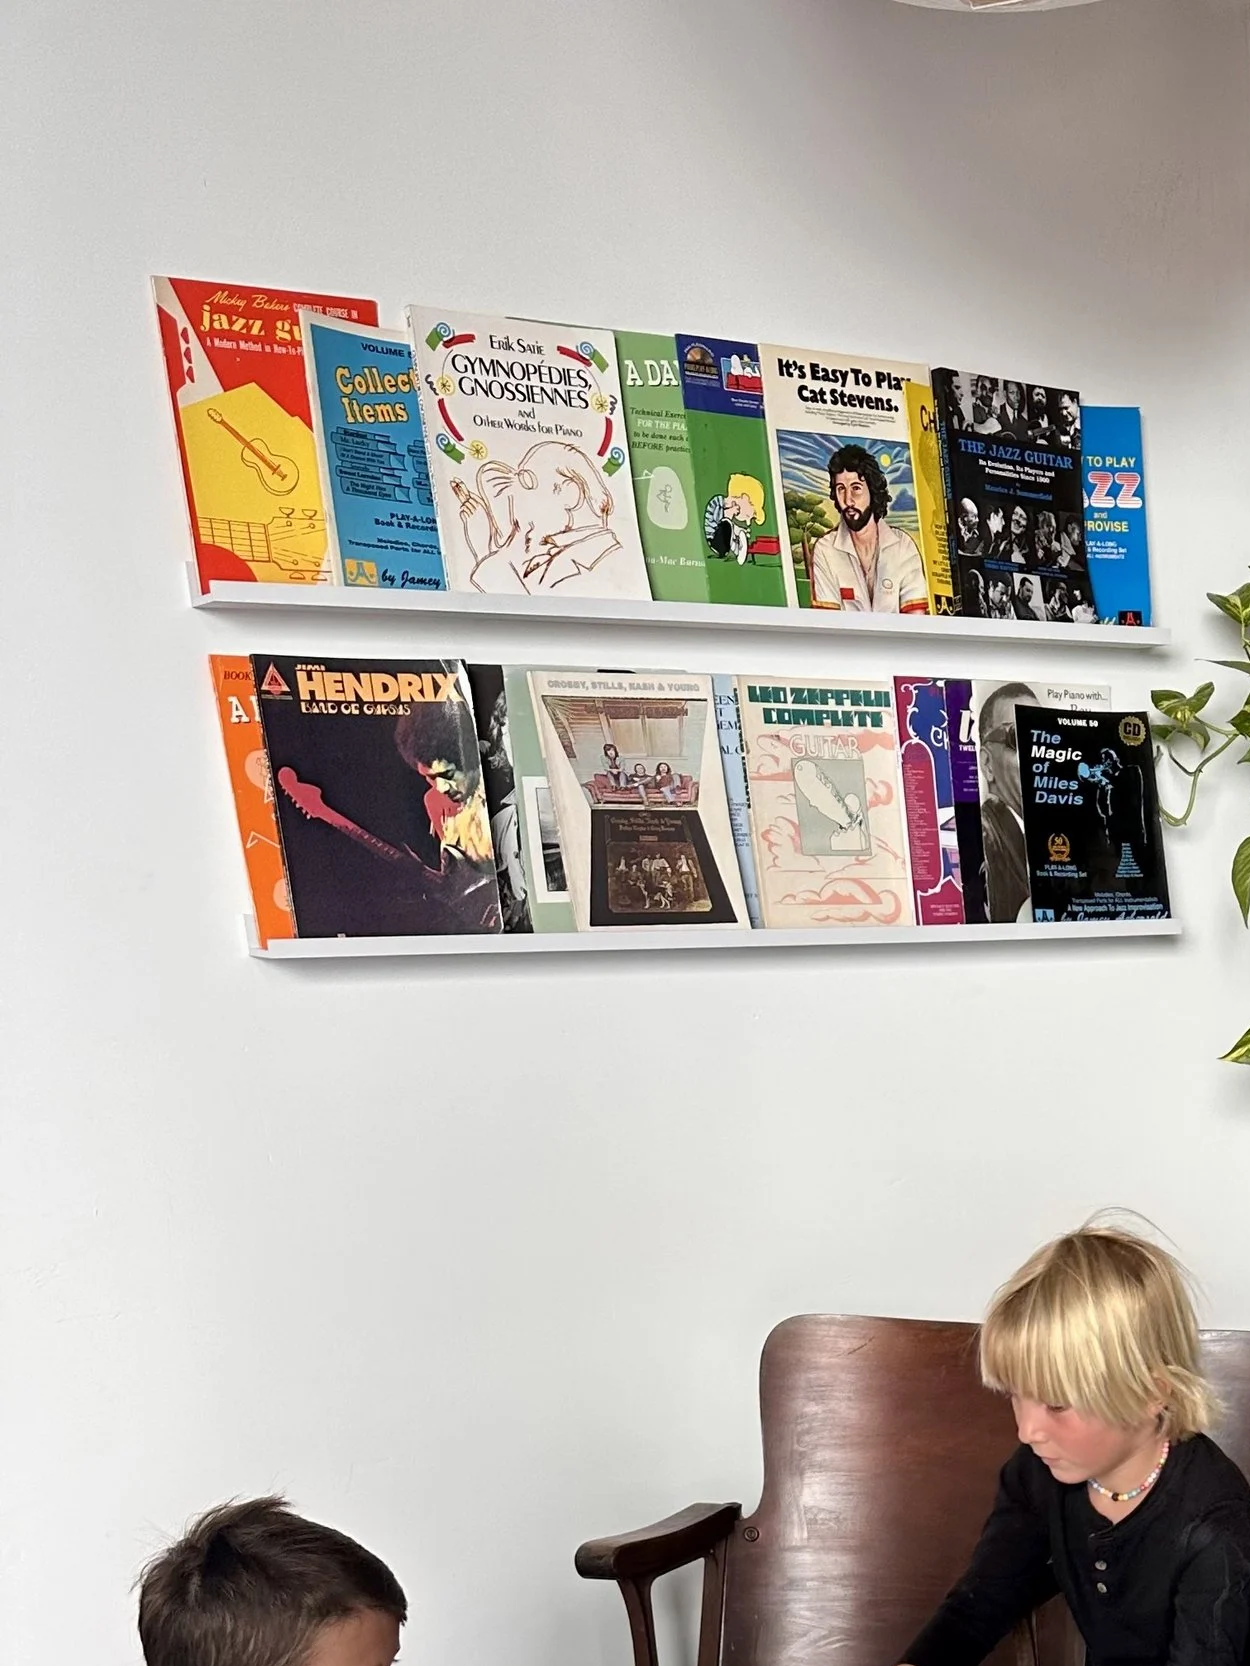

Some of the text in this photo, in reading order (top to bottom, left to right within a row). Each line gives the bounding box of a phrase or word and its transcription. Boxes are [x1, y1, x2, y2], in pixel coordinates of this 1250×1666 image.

[206, 290, 247, 311] Mickey
[200, 304, 265, 336] jazz
[361, 342, 405, 357] VOLUME
[451, 353, 592, 391] GYMNOPÉDIES,
[624, 360, 644, 387] A
[777, 358, 807, 379] It's
[809, 362, 849, 388] Easy
[850, 367, 872, 387] To
[458, 376, 589, 410] GNOSSIENNES
[797, 384, 899, 413] Cat Stevens.
[341, 395, 409, 424] Items
[637, 419, 653, 428] FOR
[655, 420, 672, 429] THE
[651, 432, 667, 440] done
[631, 441, 664, 451] BEFORE
[959, 438, 1073, 469] THE JAZZ GUITAR
[1086, 456, 1136, 468] TO PLAY
[381, 568, 441, 589] by Jamey
[223, 670, 252, 681] BOOK
[296, 671, 465, 702] HENDRIX
[629, 682, 655, 691] NASH
[657, 683, 665, 691] &
[667, 683, 700, 692] YOUNG
[747, 685, 788, 704] LED
[1047, 688, 1063, 701] Play
[1064, 689, 1085, 700] Piano
[762, 707, 884, 728] COMPLETE
[1057, 718, 1087, 727] VOLUME
[1030, 729, 1061, 744] The
[1123, 722, 1140, 737] CD
[789, 734, 861, 759] GUITAR
[1031, 745, 1082, 763] Magic
[1032, 761, 1050, 773] of
[1033, 775, 1079, 790] Miles
[1035, 791, 1083, 805] Davis
